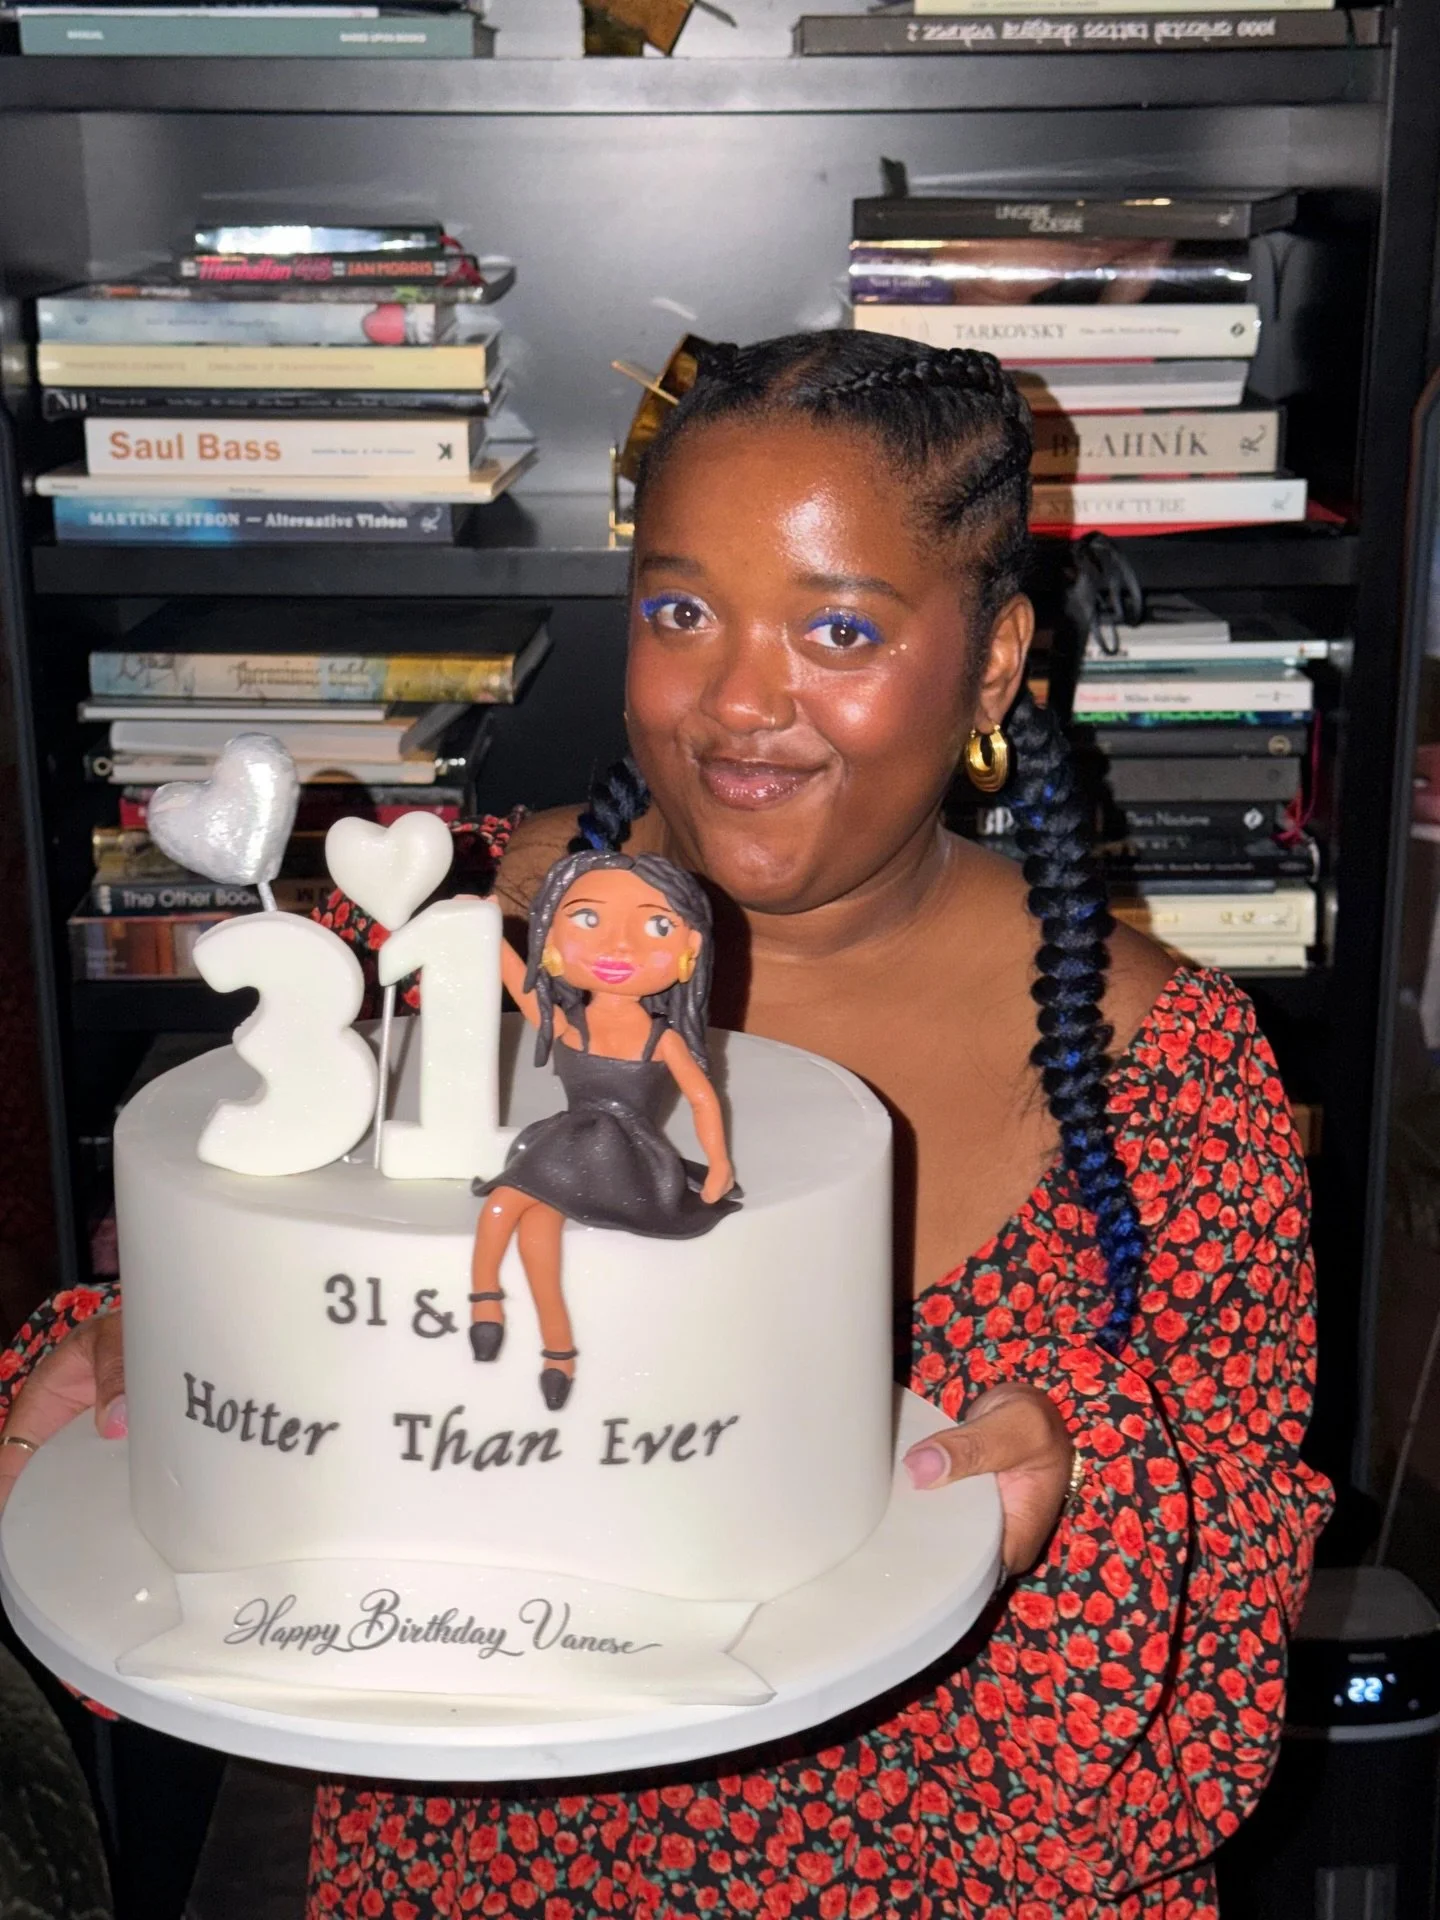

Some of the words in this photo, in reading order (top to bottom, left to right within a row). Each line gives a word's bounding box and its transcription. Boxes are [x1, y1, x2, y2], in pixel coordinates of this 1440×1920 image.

[953, 323, 1067, 340] TARKOVSKY
[109, 430, 186, 460] Saul
[198, 432, 282, 461] Bass
[88, 511, 171, 527] MARTINE
[264, 511, 354, 529] Alternative
[355, 512, 408, 529] Vision
[122, 889, 155, 908] The
[159, 888, 211, 908] Other
[324, 1273, 388, 1327] 31
[411, 1289, 459, 1339] &
[183, 1372, 339, 1456] Hotter
[393, 1405, 561, 1472] Than
[599, 1413, 740, 1466] Ever
[223, 1594, 353, 1656] Happy
[346, 1588, 525, 1660] Birthday
[1347, 1676, 1383, 1703] 22
